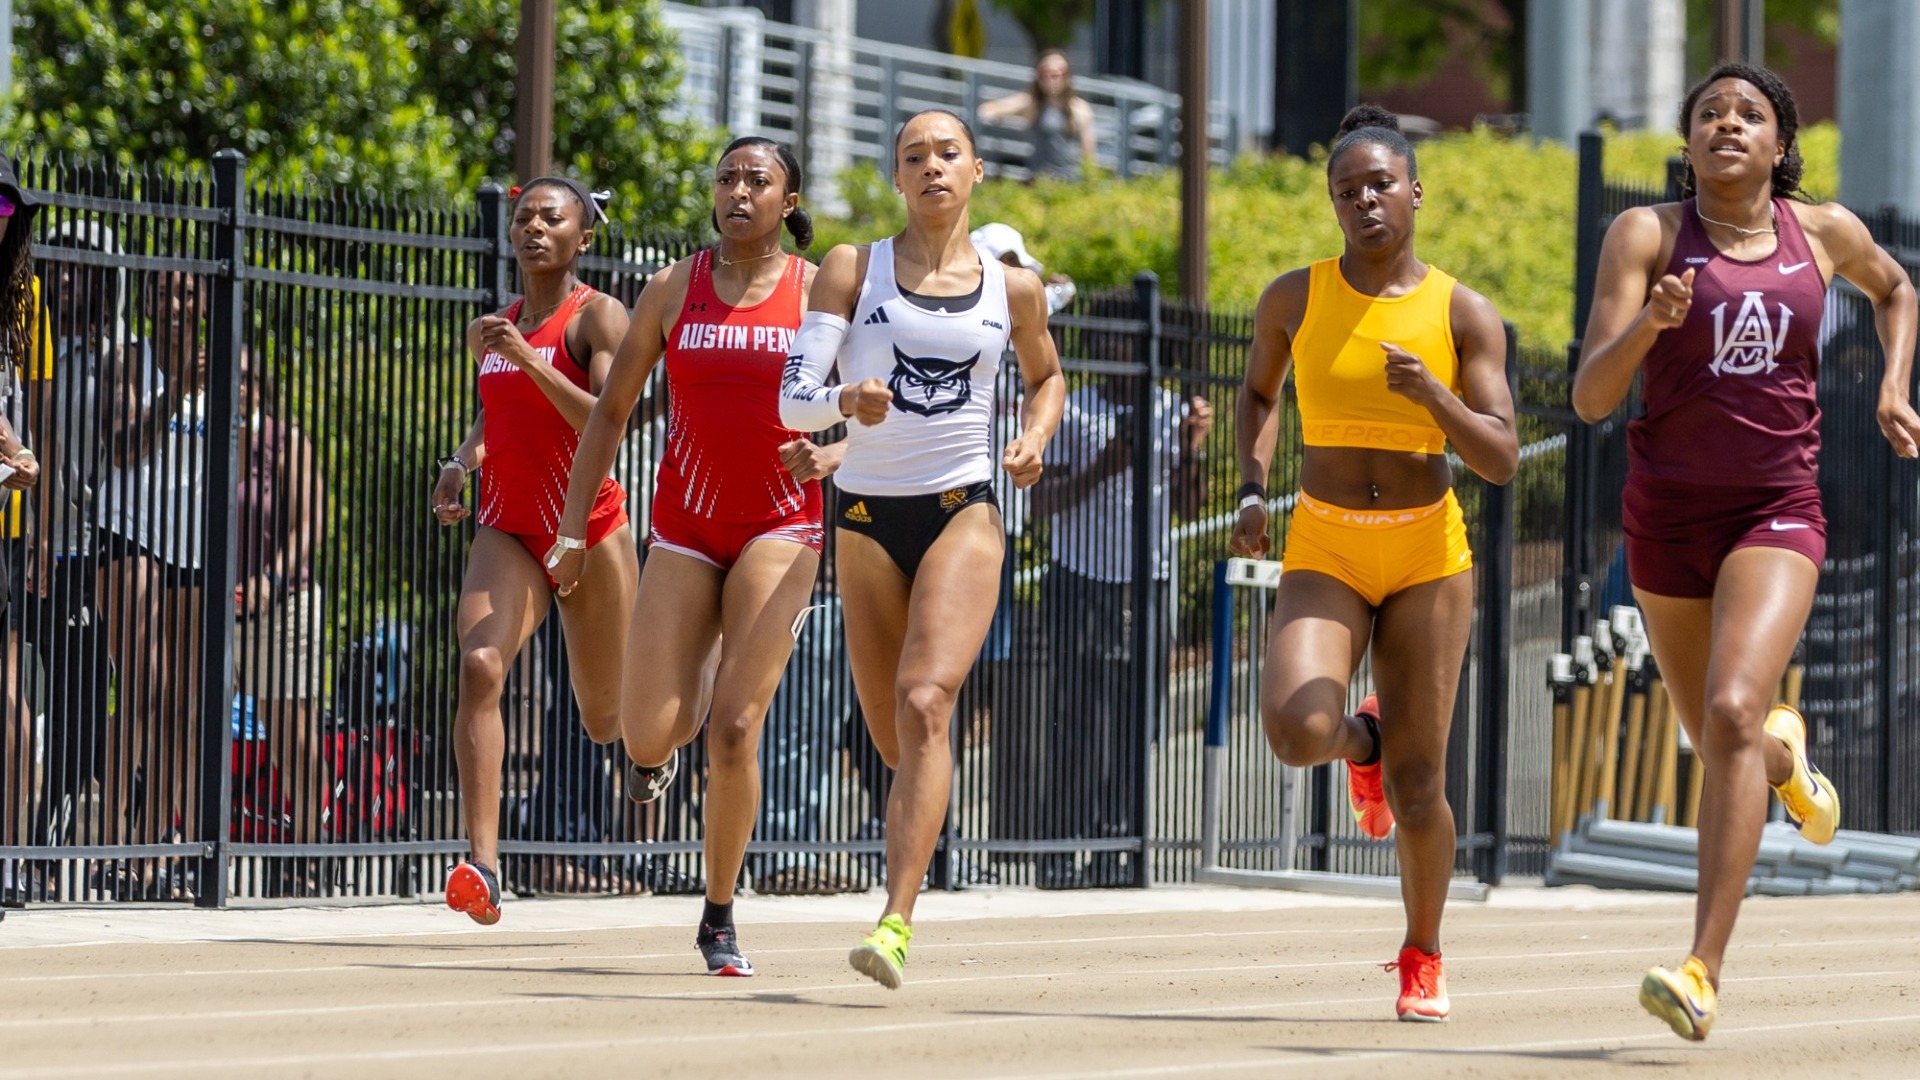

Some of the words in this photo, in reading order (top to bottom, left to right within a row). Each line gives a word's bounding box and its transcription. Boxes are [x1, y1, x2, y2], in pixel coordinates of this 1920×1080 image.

[678, 323, 748, 350] AUSTIN
[844, 511, 872, 523] adidas
[1343, 513, 1415, 524] NIKE
